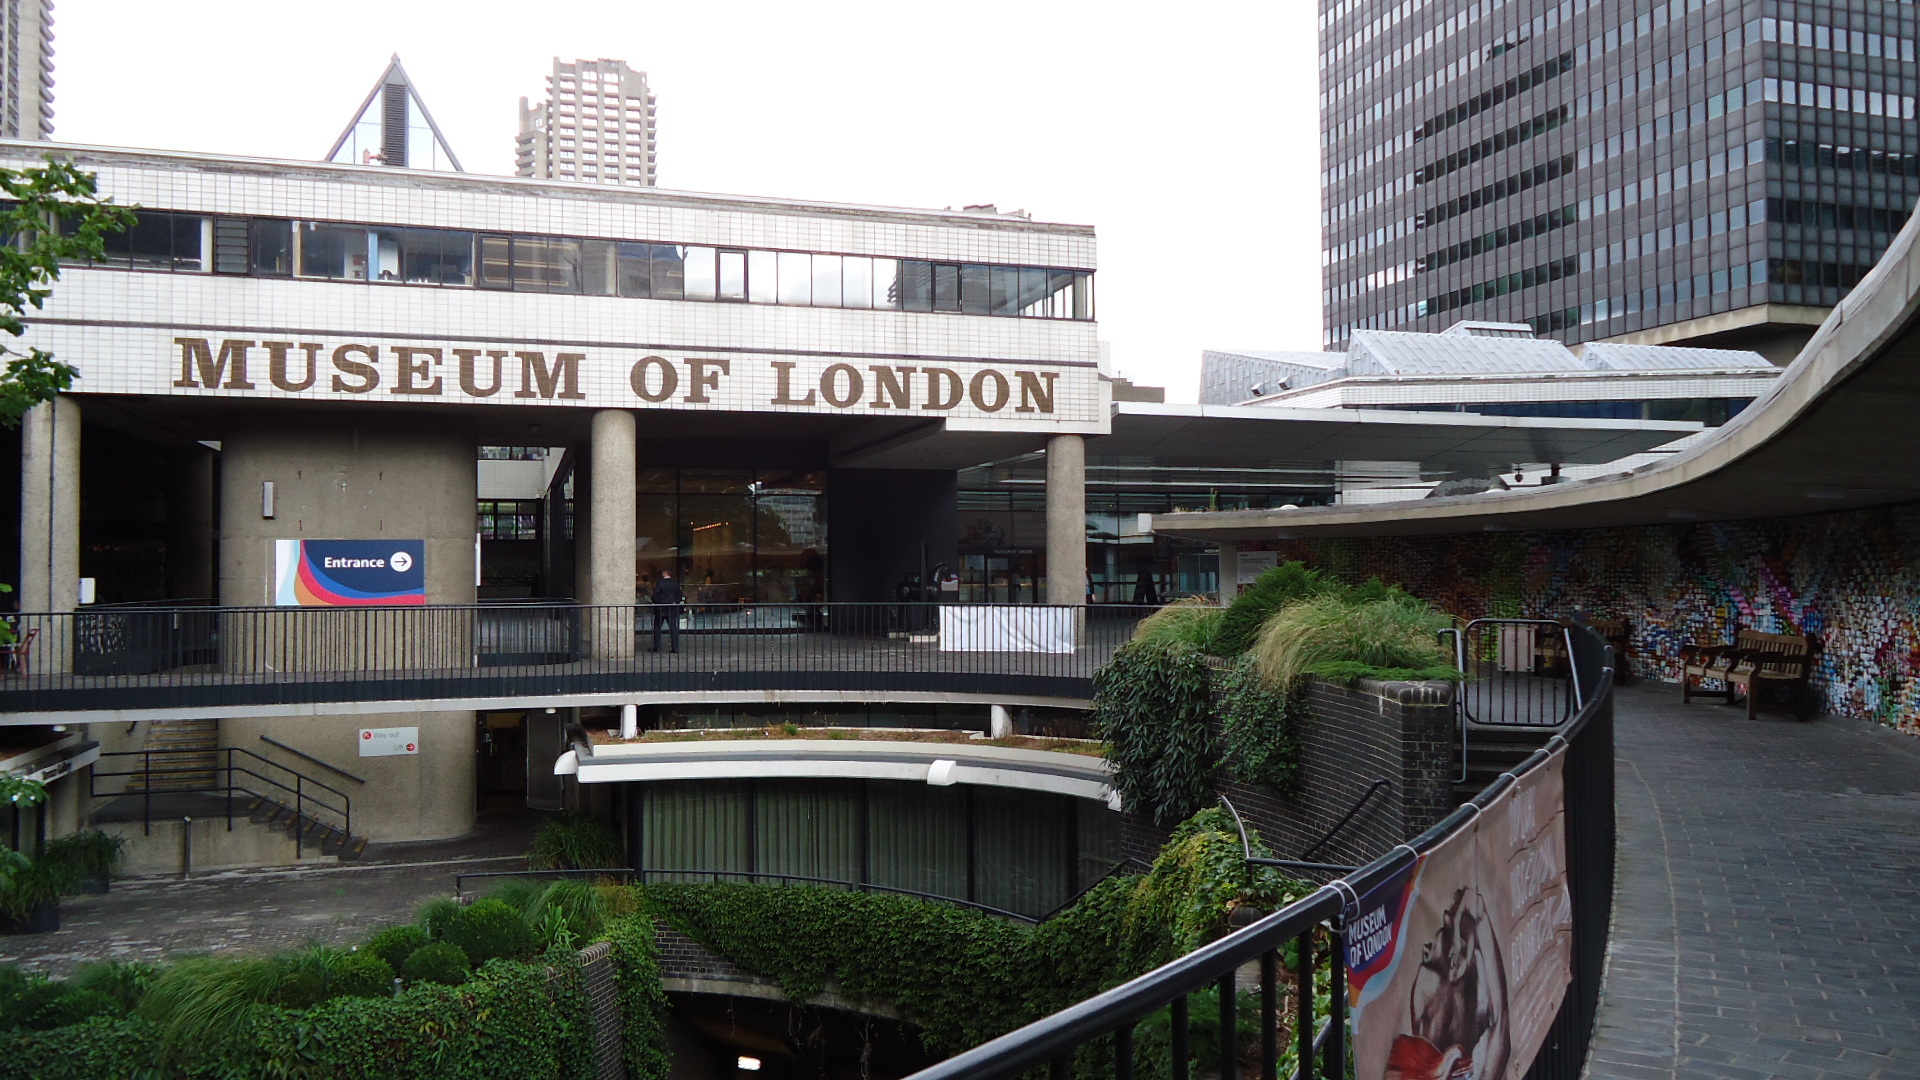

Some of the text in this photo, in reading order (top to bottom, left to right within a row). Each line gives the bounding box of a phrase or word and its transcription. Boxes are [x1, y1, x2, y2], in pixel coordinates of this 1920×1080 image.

[173, 336, 1060, 414] MUSEUM OF LONDON
[324, 556, 385, 568] Entrance
[1349, 903, 1387, 946] MUSEUM
[1350, 921, 1393, 969] OF LONDON
